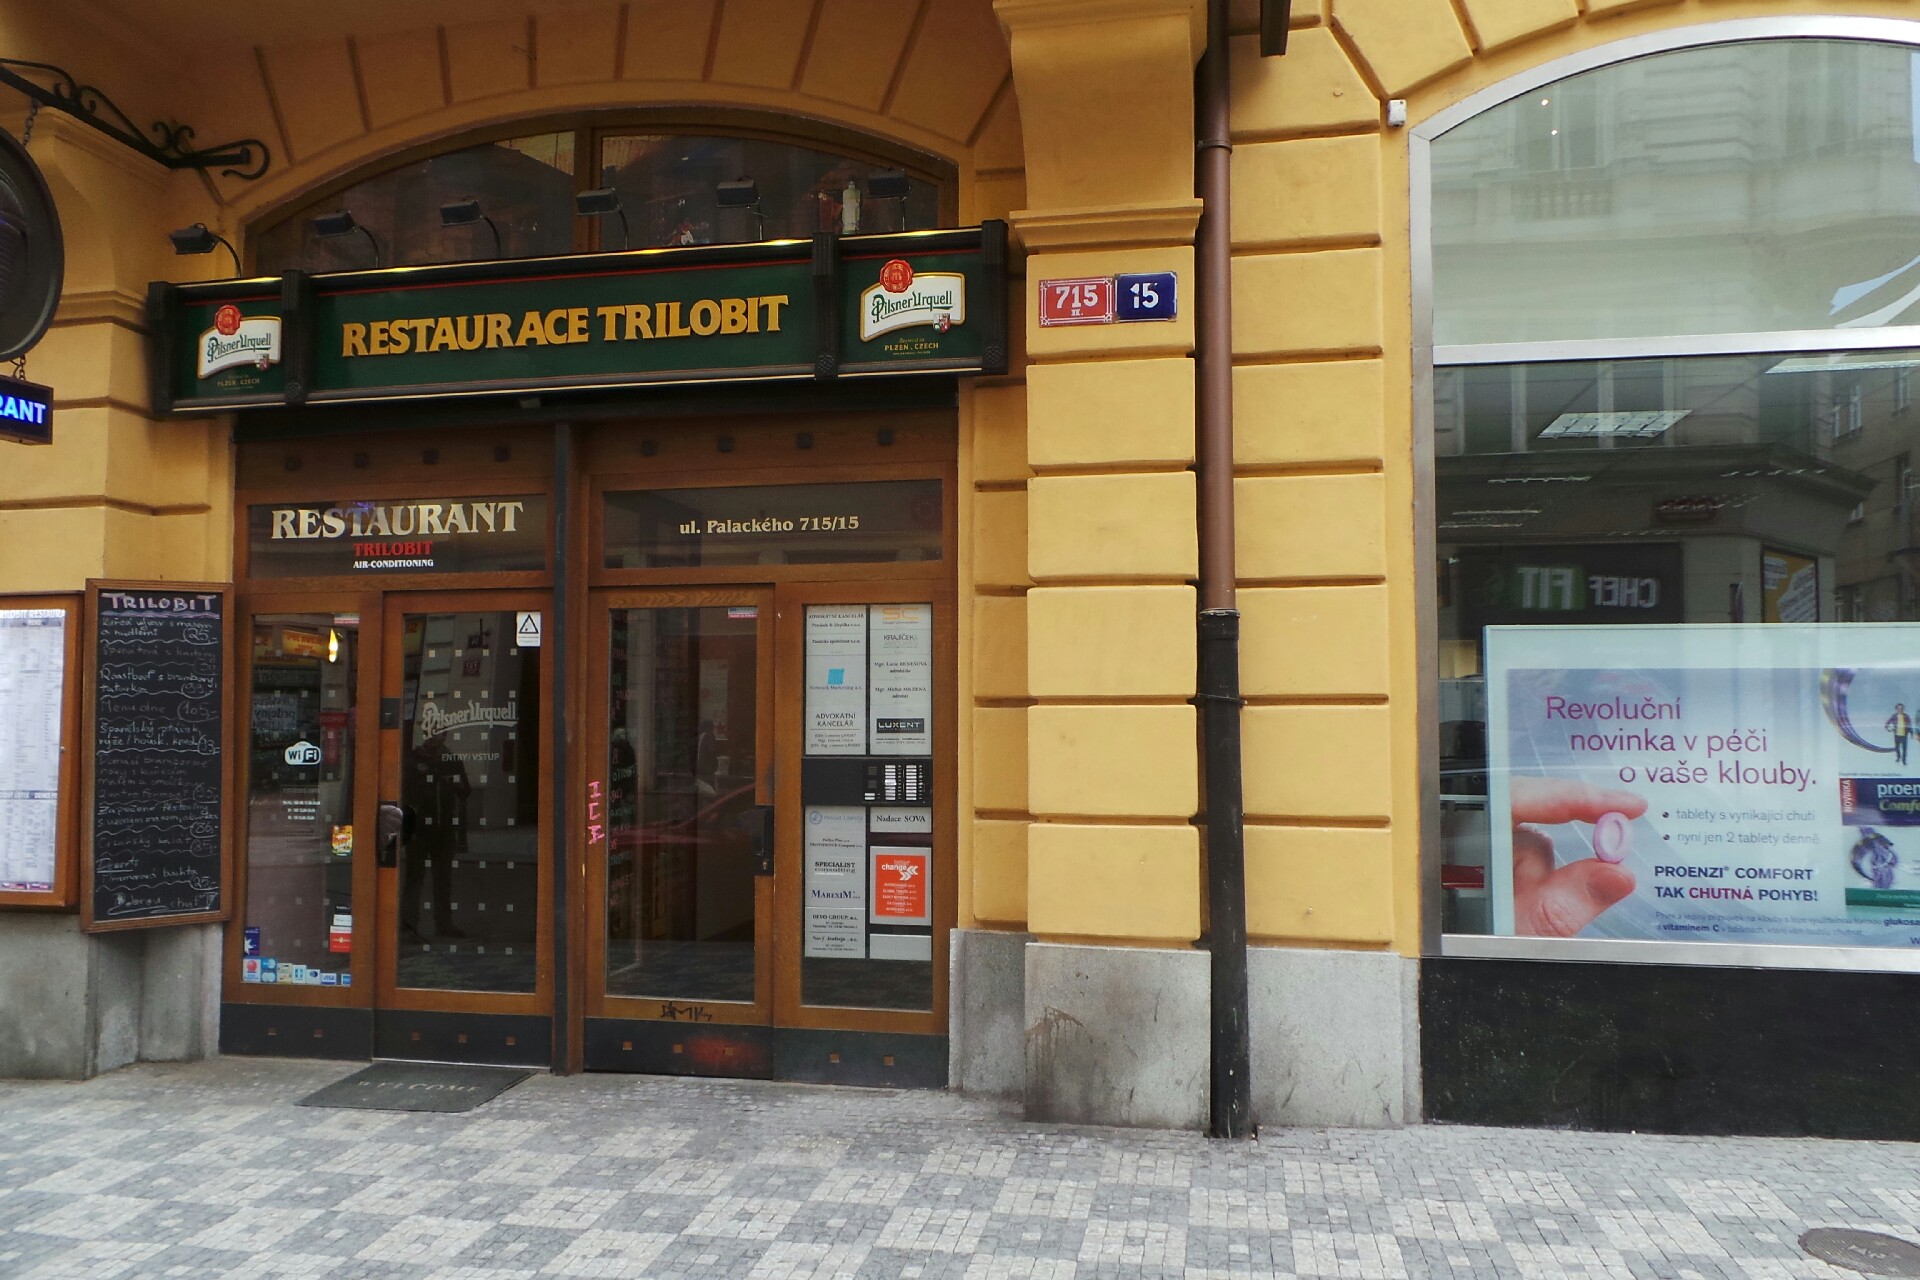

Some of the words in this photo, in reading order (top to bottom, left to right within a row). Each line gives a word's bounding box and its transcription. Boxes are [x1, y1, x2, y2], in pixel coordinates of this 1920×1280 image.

[1056, 285, 1098, 309] 715
[1130, 283, 1159, 309] 15
[871, 294, 913, 324] Pilsner
[912, 291, 952, 312] Urquell
[342, 308, 590, 357] RESTAURACE
[597, 295, 788, 341] TRILOBIT
[207, 336, 240, 363] Pilsner
[239, 333, 271, 352] Urquell
[0, 394, 46, 424] ANT
[271, 502, 523, 540] RESTAURANT
[680, 521, 701, 534] ul.
[707, 517, 794, 534] Palackého
[800, 516, 859, 531] 715/15
[353, 541, 434, 557] TRILOBIT
[353, 559, 434, 569] AIR-CONDITIONING
[101, 593, 217, 611] TRILOBIT
[1546, 696, 1682, 720] Revoluční
[421, 702, 471, 740] Pilsner
[468, 700, 516, 728] Urquell
[1570, 728, 1676, 752] novinka
[1684, 735, 1698, 751] v
[1706, 729, 1768, 758] péči
[1619, 766, 1636, 783] o
[1646, 760, 1708, 784] vaše
[1719, 760, 1817, 792] klouby.
[875, 814, 902, 822] Nadace
[904, 814, 926, 822] SOVA
[1676, 809, 1717, 822] tablety
[1719, 812, 1726, 820] s
[1704, 833, 1722, 845] jen
[1726, 832, 1735, 843] 2
[1738, 833, 1779, 846] tablety
[881, 863, 908, 872] change
[1735, 868, 1813, 880] COMFORT
[1655, 886, 1685, 898] TAK
[1689, 886, 1753, 900] CHUTNÁ
[1759, 889, 1818, 902] POHYB!
[1713, 924, 1719, 932] C
